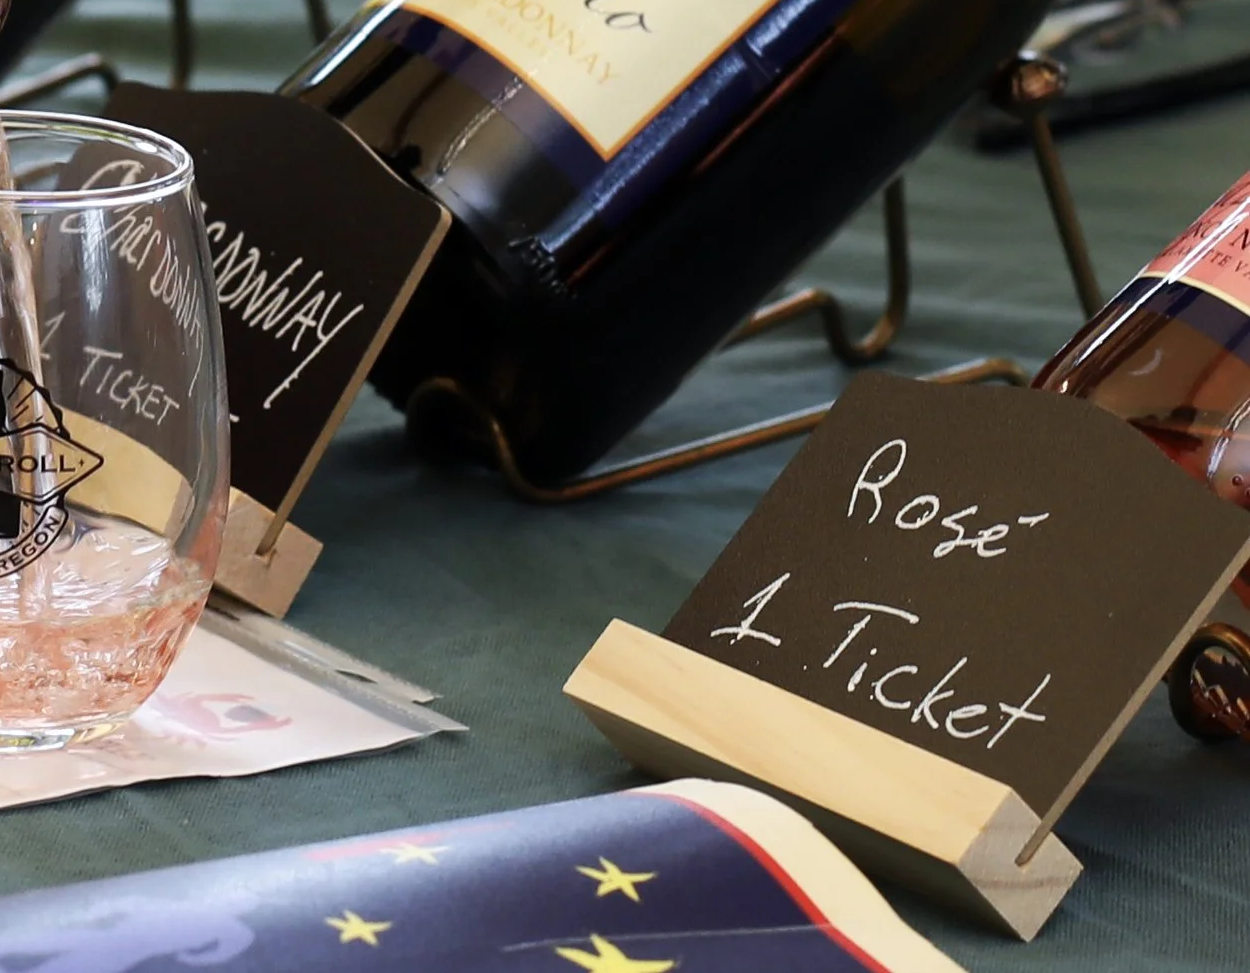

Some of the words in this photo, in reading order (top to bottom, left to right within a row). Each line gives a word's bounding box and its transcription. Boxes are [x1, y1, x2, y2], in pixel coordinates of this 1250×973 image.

[78, 345, 181, 426] TICKET
[710, 571, 791, 648] 1
[821, 599, 1052, 749] Ticket
